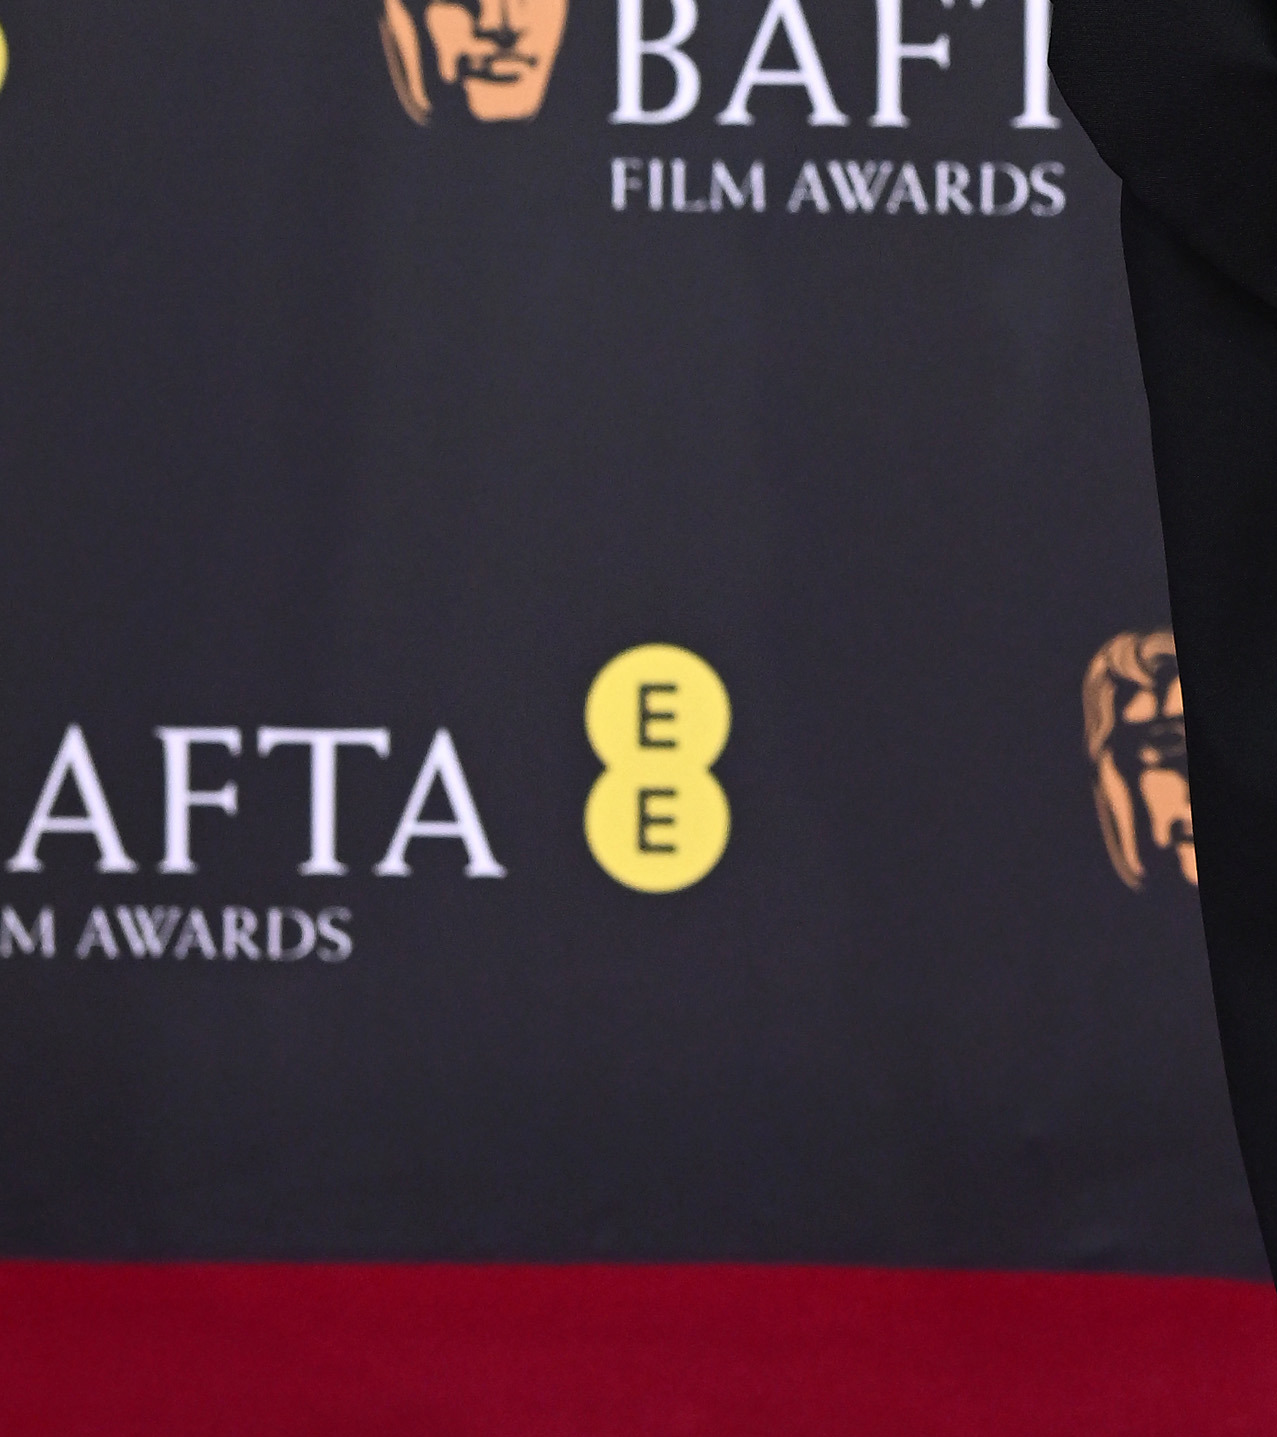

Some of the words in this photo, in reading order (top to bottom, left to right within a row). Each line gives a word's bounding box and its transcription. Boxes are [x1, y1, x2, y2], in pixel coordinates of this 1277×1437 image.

[612, 158, 765, 211] FILM
[789, 161, 1065, 215] AWARDS
[10, 726, 504, 877] AFTA
[76, 908, 351, 957] AWARDS
